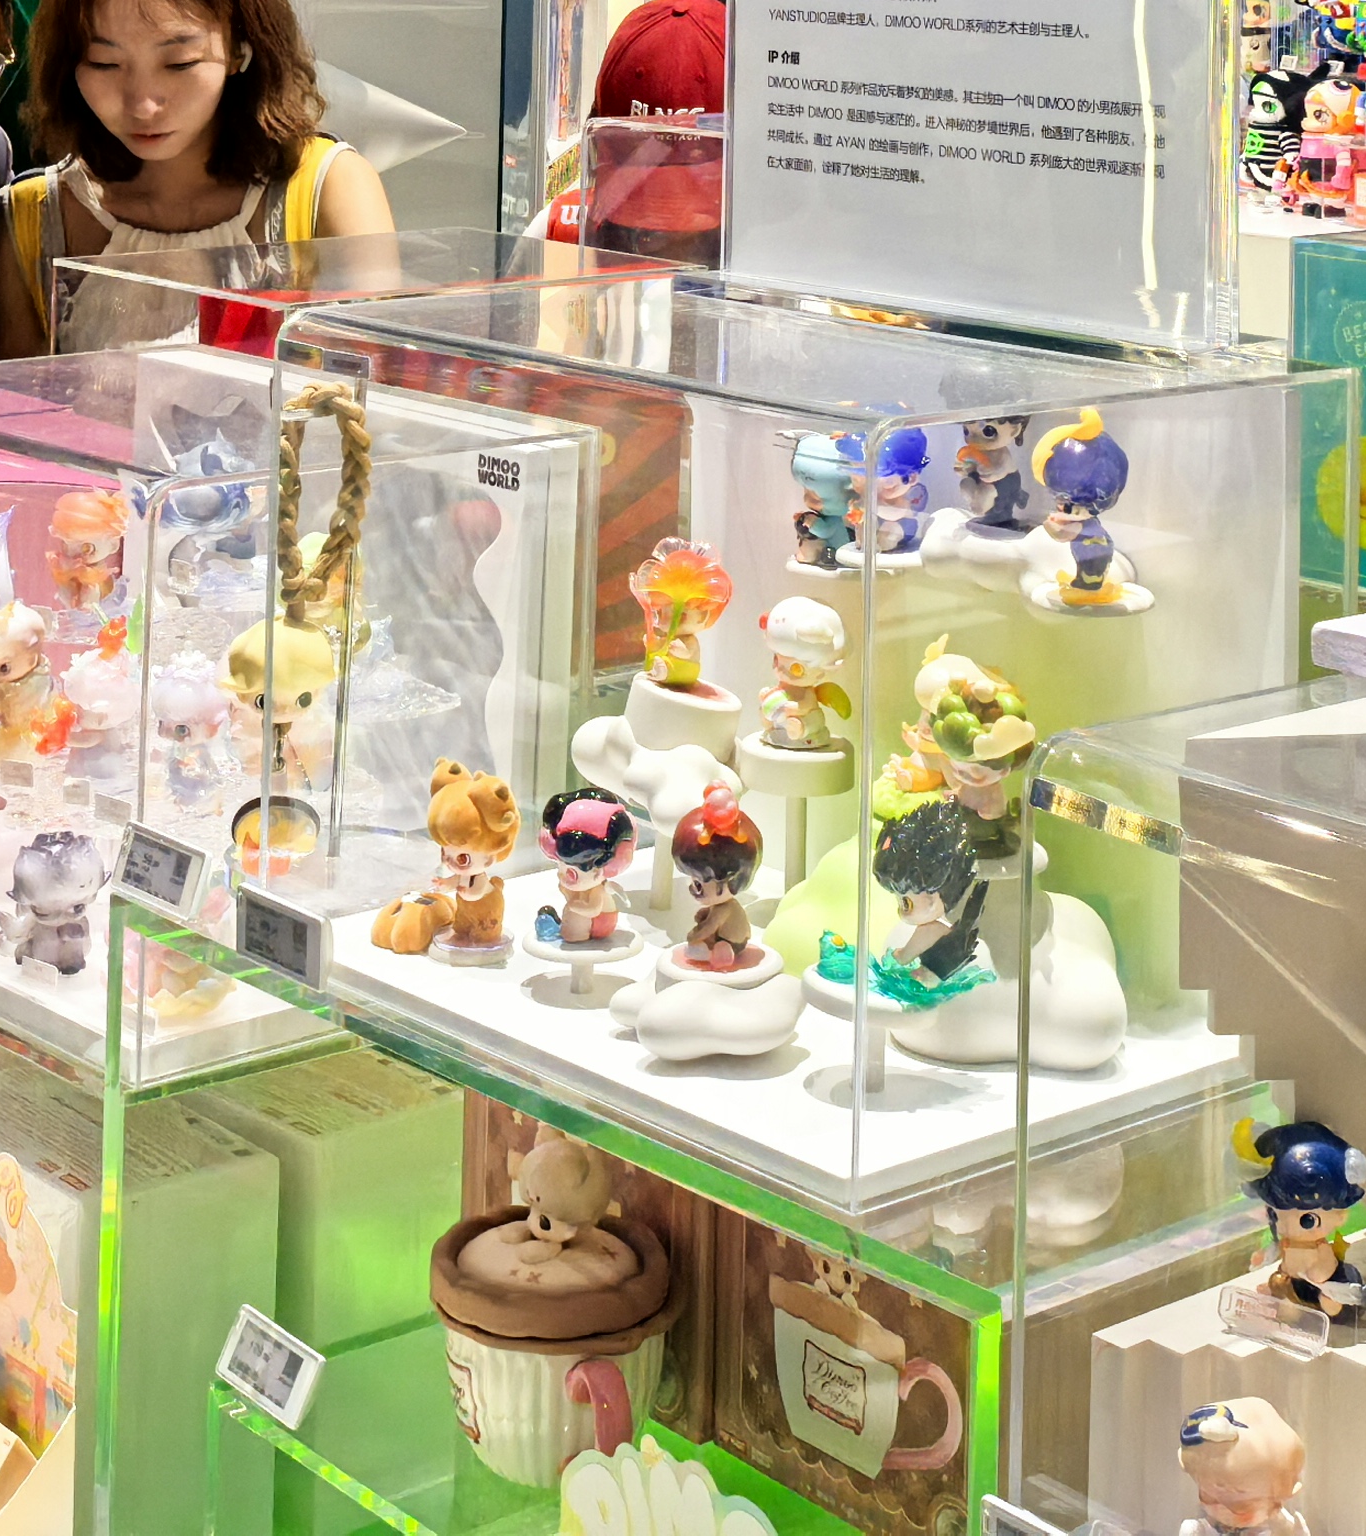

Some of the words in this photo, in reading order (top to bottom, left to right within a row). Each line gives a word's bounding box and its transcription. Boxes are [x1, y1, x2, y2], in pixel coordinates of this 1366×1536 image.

[768, 50, 779, 64] IP
[781, 50, 800, 65] 介绍
[767, 75, 800, 90] DIMOO
[801, 78, 839, 93] WORLD
[1037, 96, 1075, 111] DIMOO
[1077, 98, 1166, 119] 的小男孩展开现
[767, 102, 805, 118] 实生活中
[808, 105, 843, 121] DIMOO
[835, 135, 866, 151] AYAN
[980, 148, 1026, 166] WORLD
[1029, 153, 1166, 180] 系列庞大的世界观逐渐现
[477, 453, 521, 477] DIMOO
[477, 468, 521, 492] WORLD
